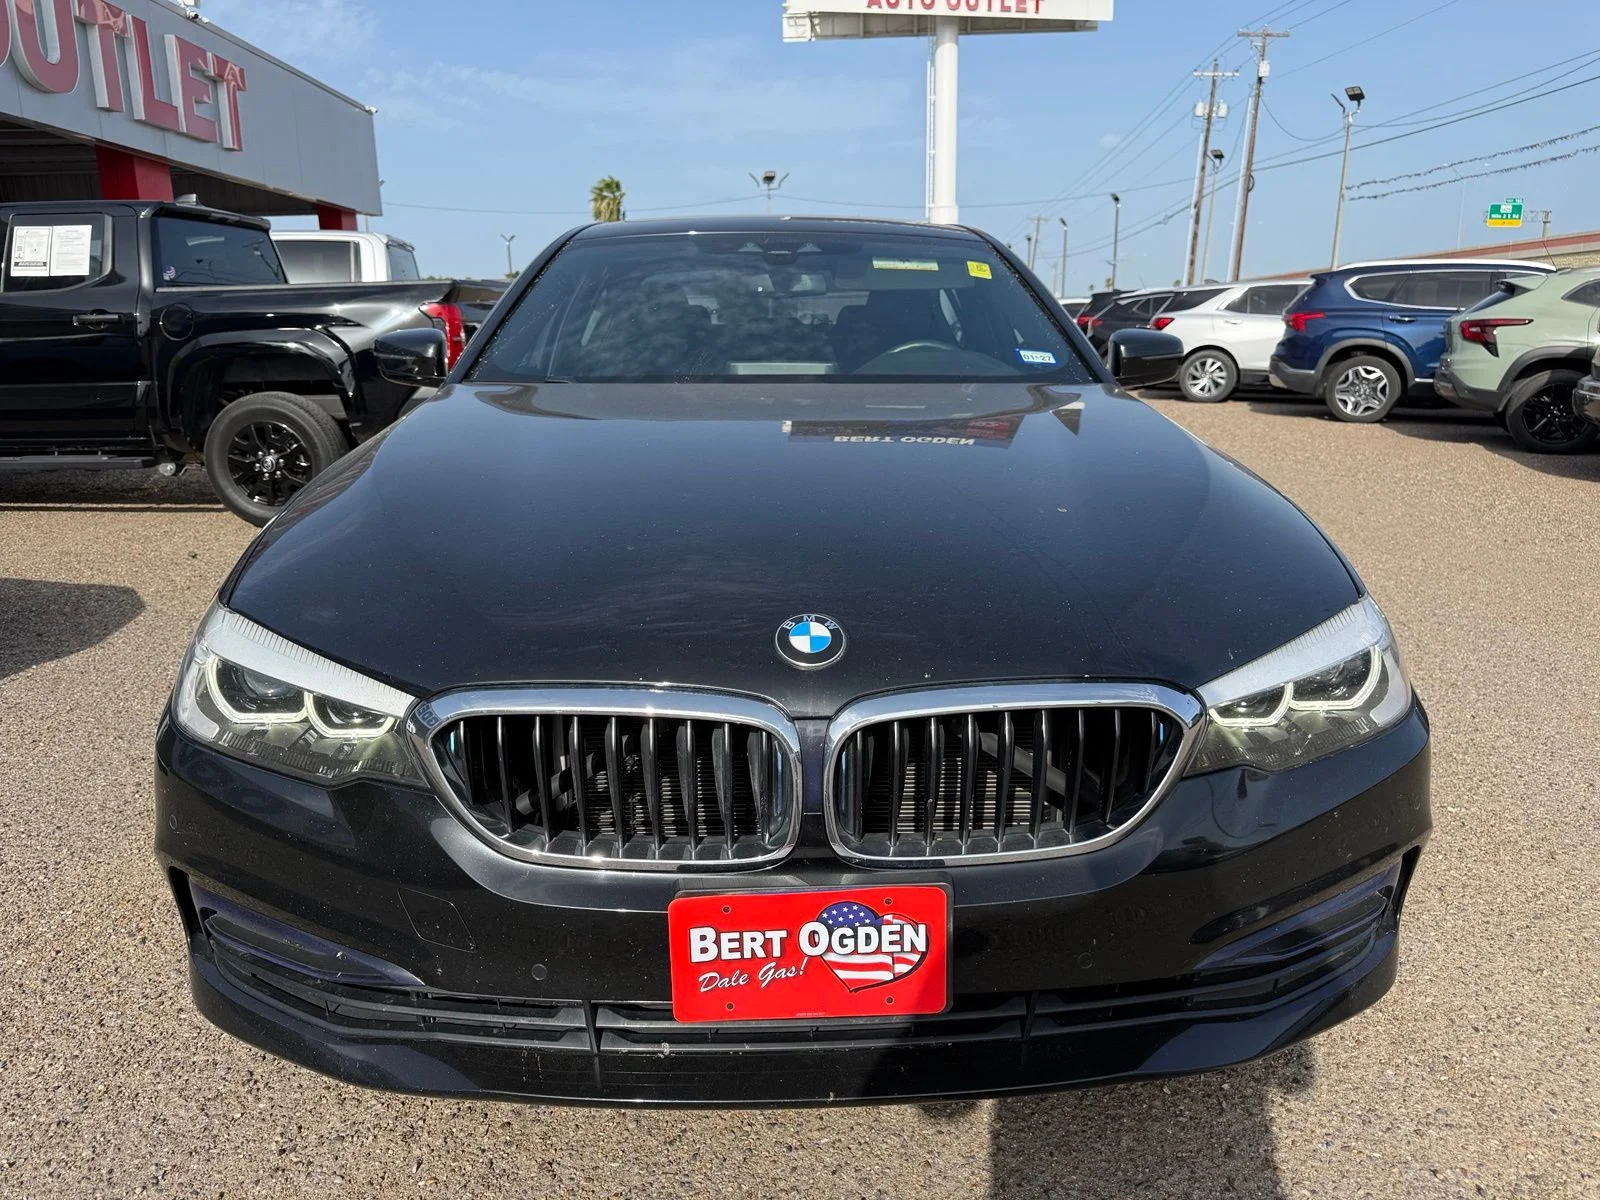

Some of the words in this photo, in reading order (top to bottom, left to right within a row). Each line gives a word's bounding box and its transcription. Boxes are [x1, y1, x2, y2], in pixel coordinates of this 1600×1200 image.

[0, 0, 247, 151] UTLET
[782, 615, 838, 630] BMW
[699, 969, 750, 993] Dale
[758, 956, 808, 988] Gas!
